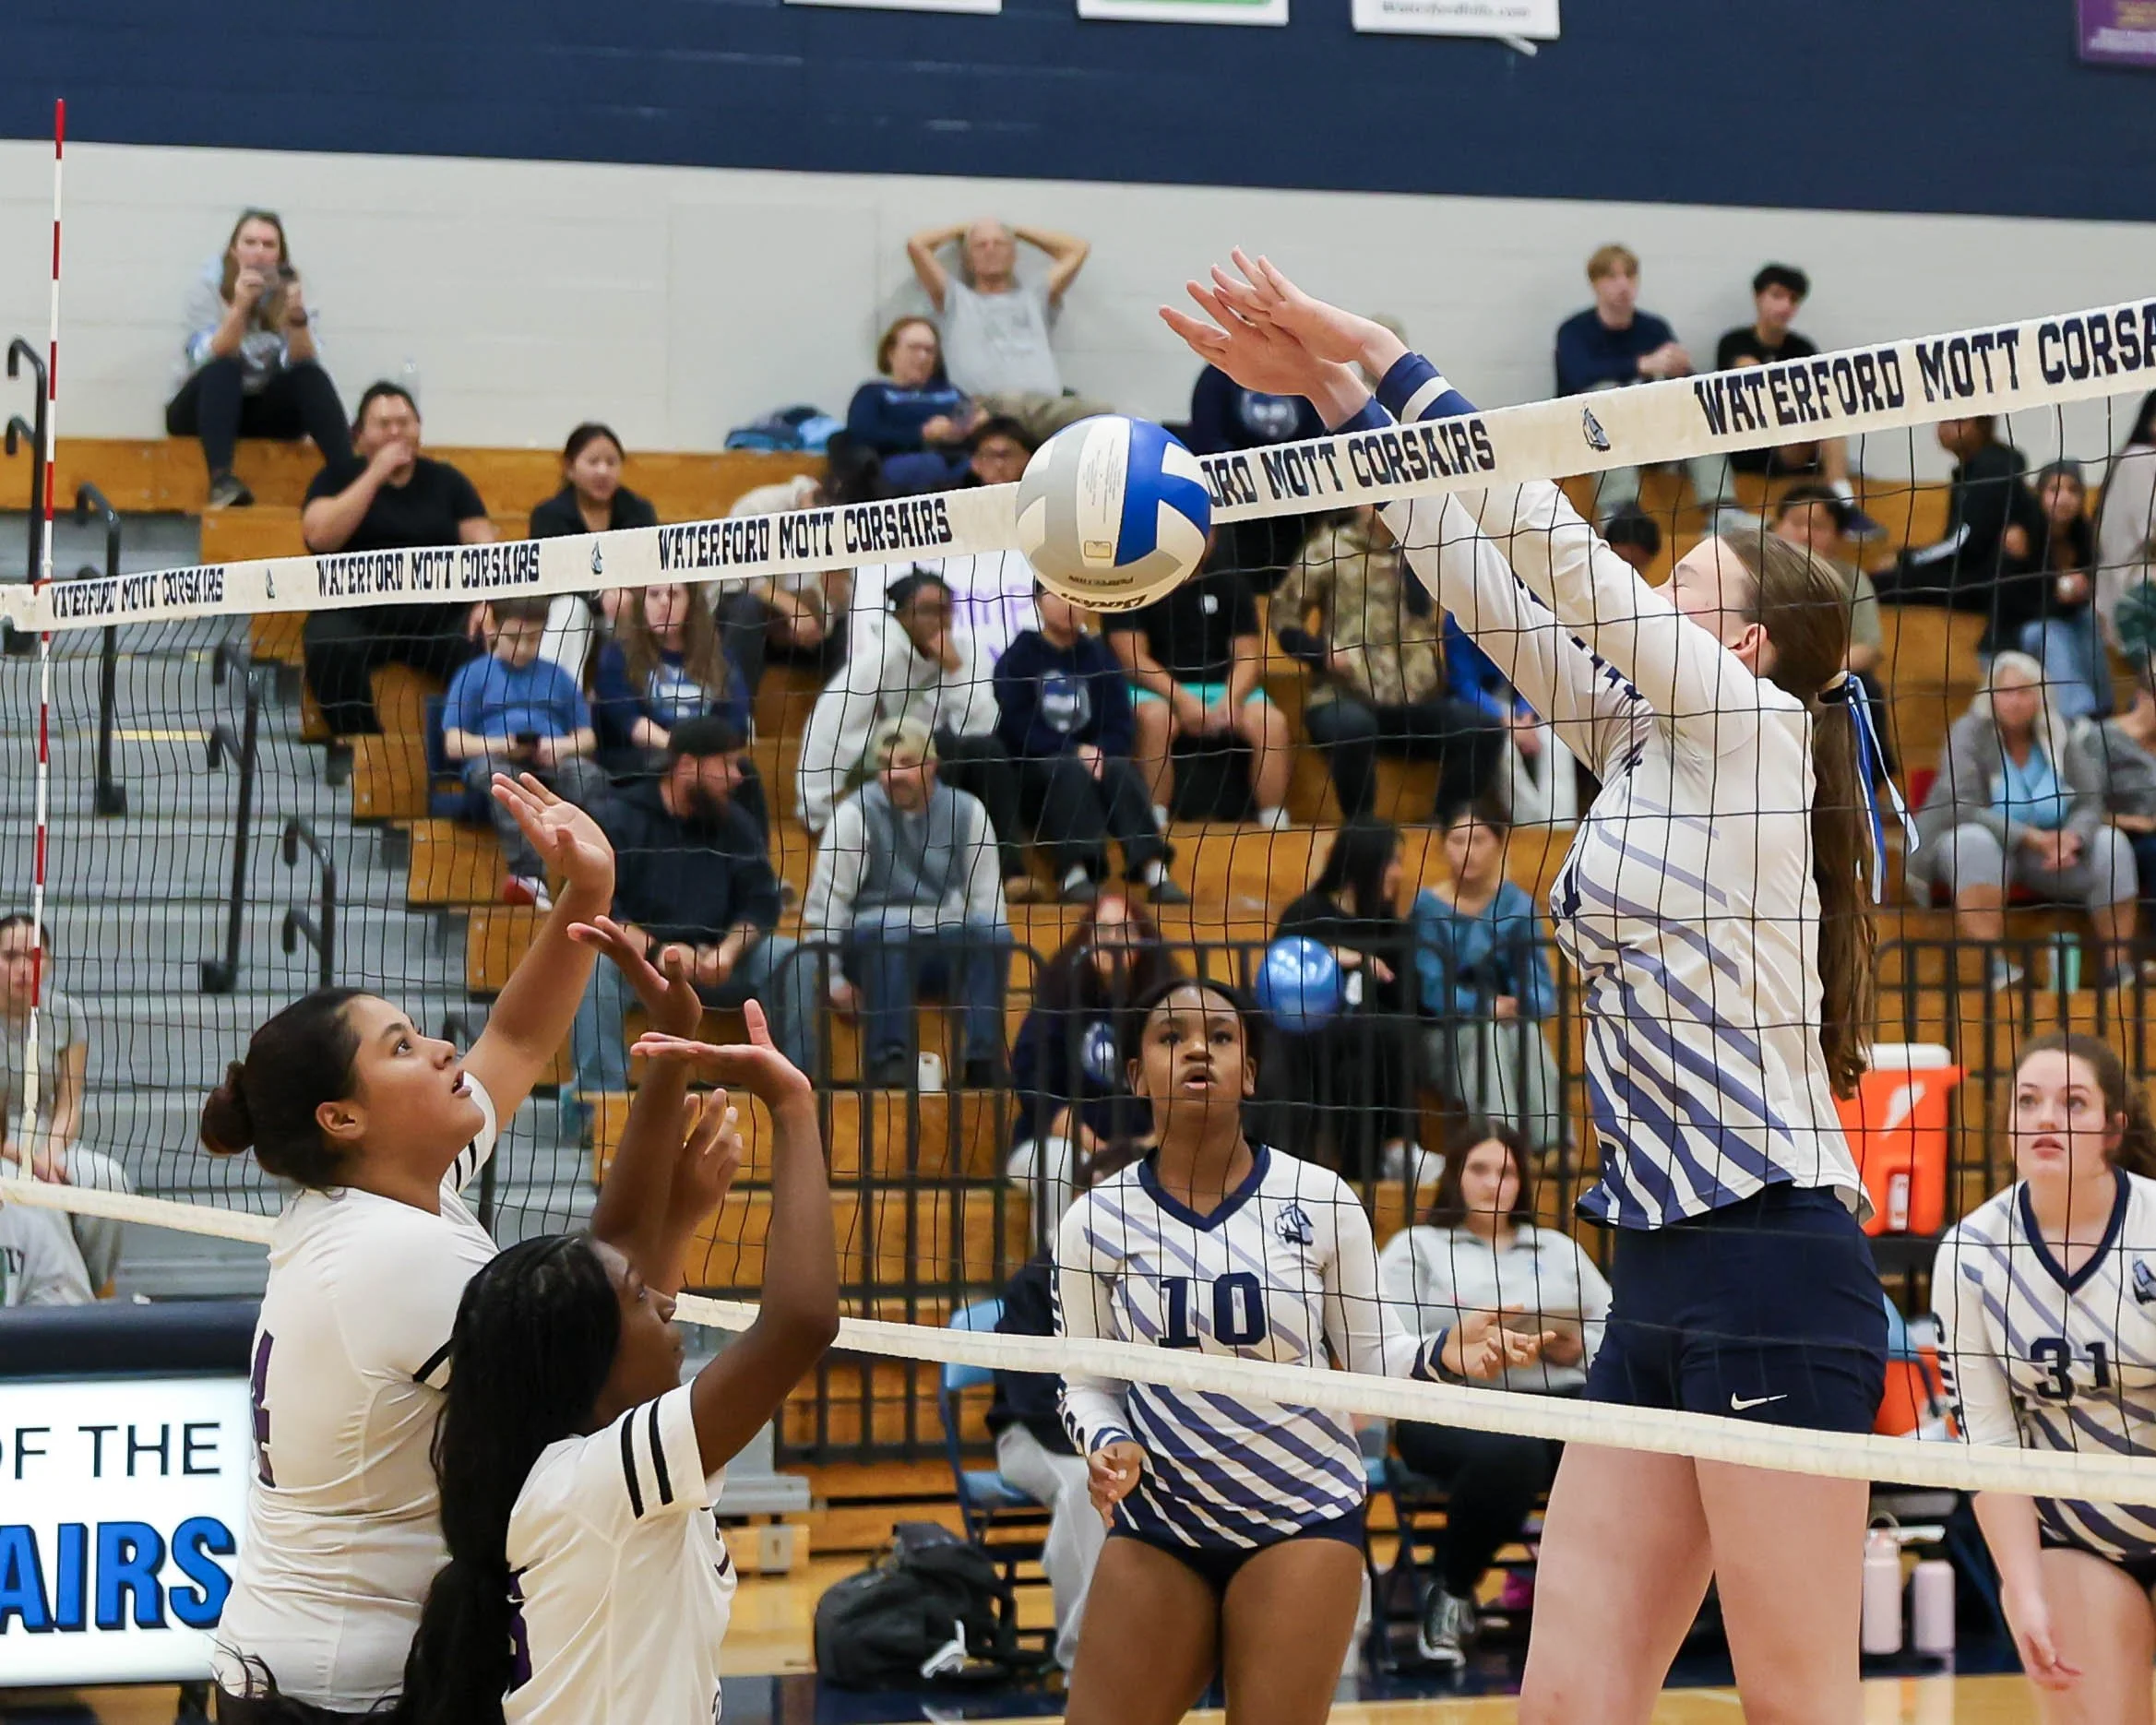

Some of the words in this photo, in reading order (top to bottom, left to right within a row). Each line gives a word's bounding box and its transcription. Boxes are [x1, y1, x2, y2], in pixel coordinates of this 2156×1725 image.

[1694, 348, 1905, 436] WATERFORD
[1916, 328, 2020, 403] MOTT
[1200, 455, 1258, 507] ORD
[1260, 442, 1343, 500] MOTT
[1348, 419, 1496, 488] CORSAIRS
[316, 553, 404, 598] WATERFORD
[411, 550, 455, 590] MOTT
[460, 542, 541, 589] CORSAIRS
[658, 518, 769, 570] WATERFORD
[779, 511, 835, 560] MOTT
[843, 497, 953, 553] CORSAIRS
[1157, 1271, 1267, 1348] 10
[2030, 1337, 2112, 1400] 31
[0, 1426, 51, 1480] F
[77, 1422, 220, 1478] THE
[0, 1516, 236, 1635] AIRS
